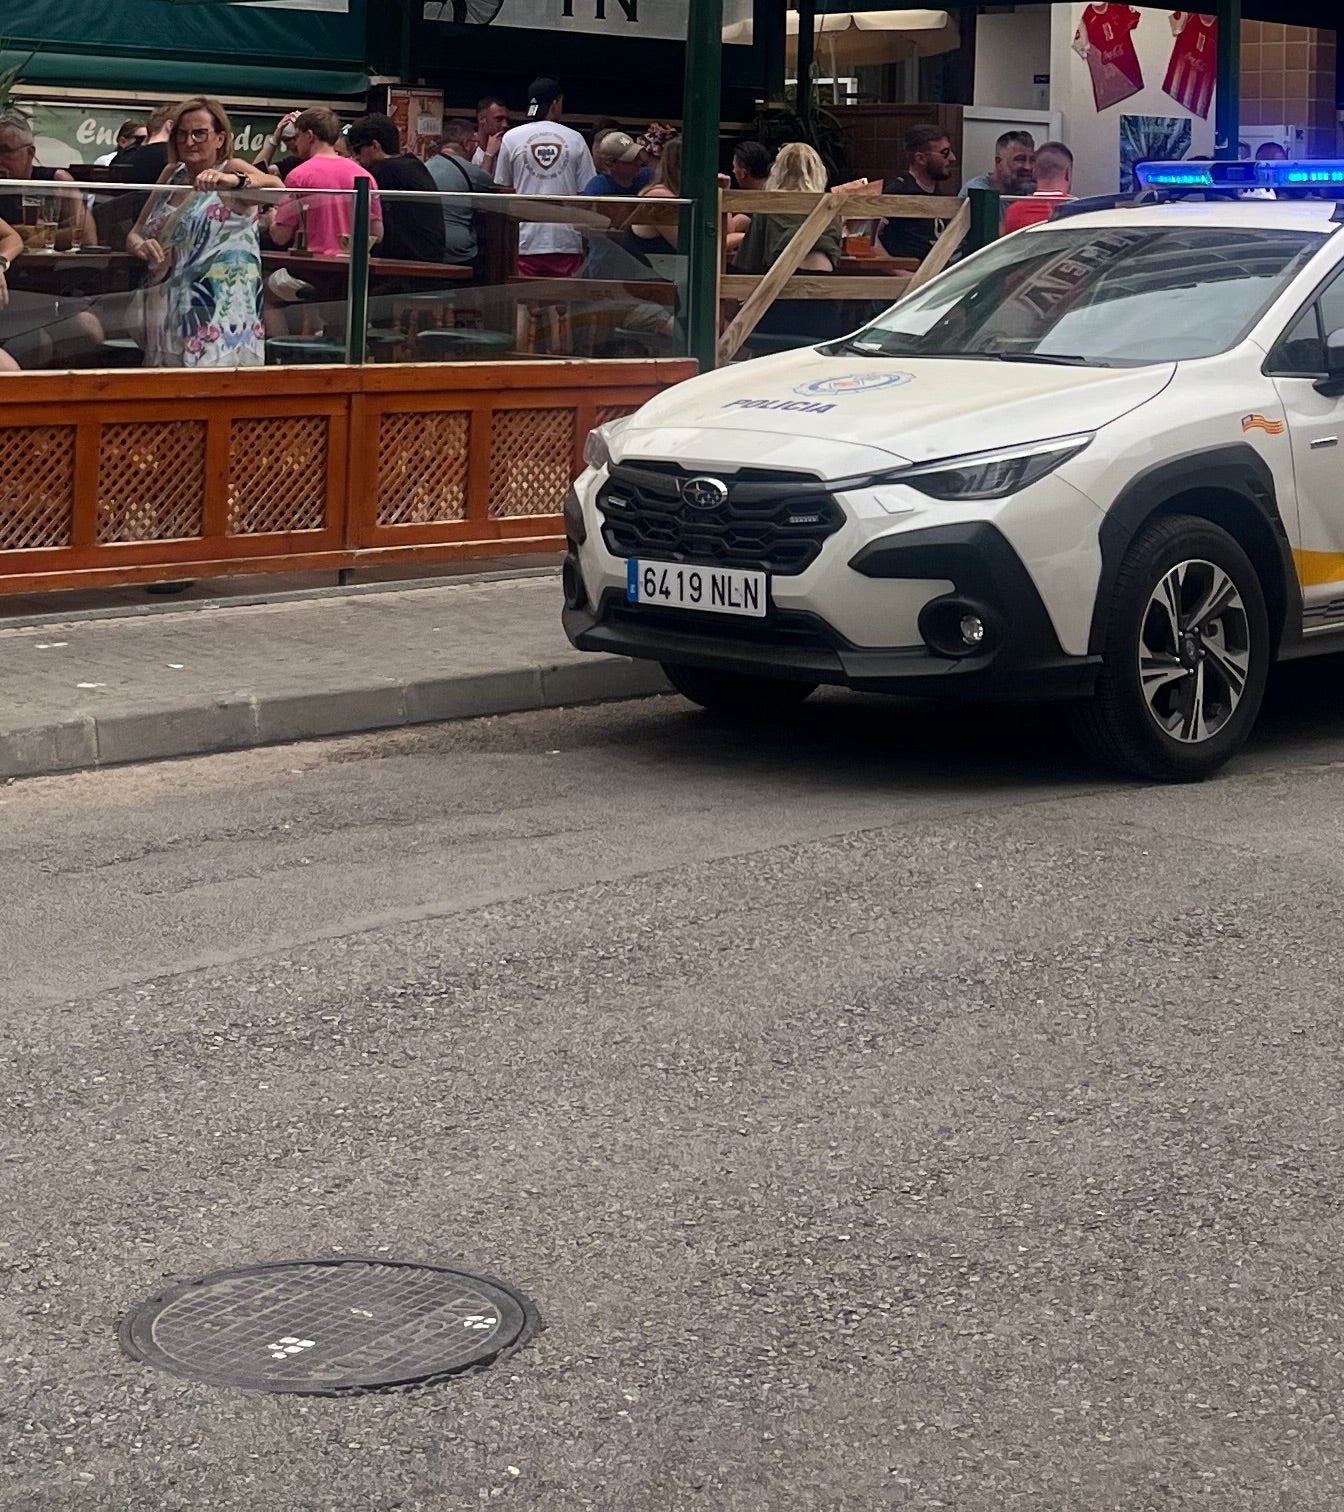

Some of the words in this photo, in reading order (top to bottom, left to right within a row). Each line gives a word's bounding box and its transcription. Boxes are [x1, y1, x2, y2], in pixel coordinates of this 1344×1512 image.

[721, 398, 839, 414] POLICIA
[644, 567, 702, 603] 6419
[711, 574, 759, 610] NLN
